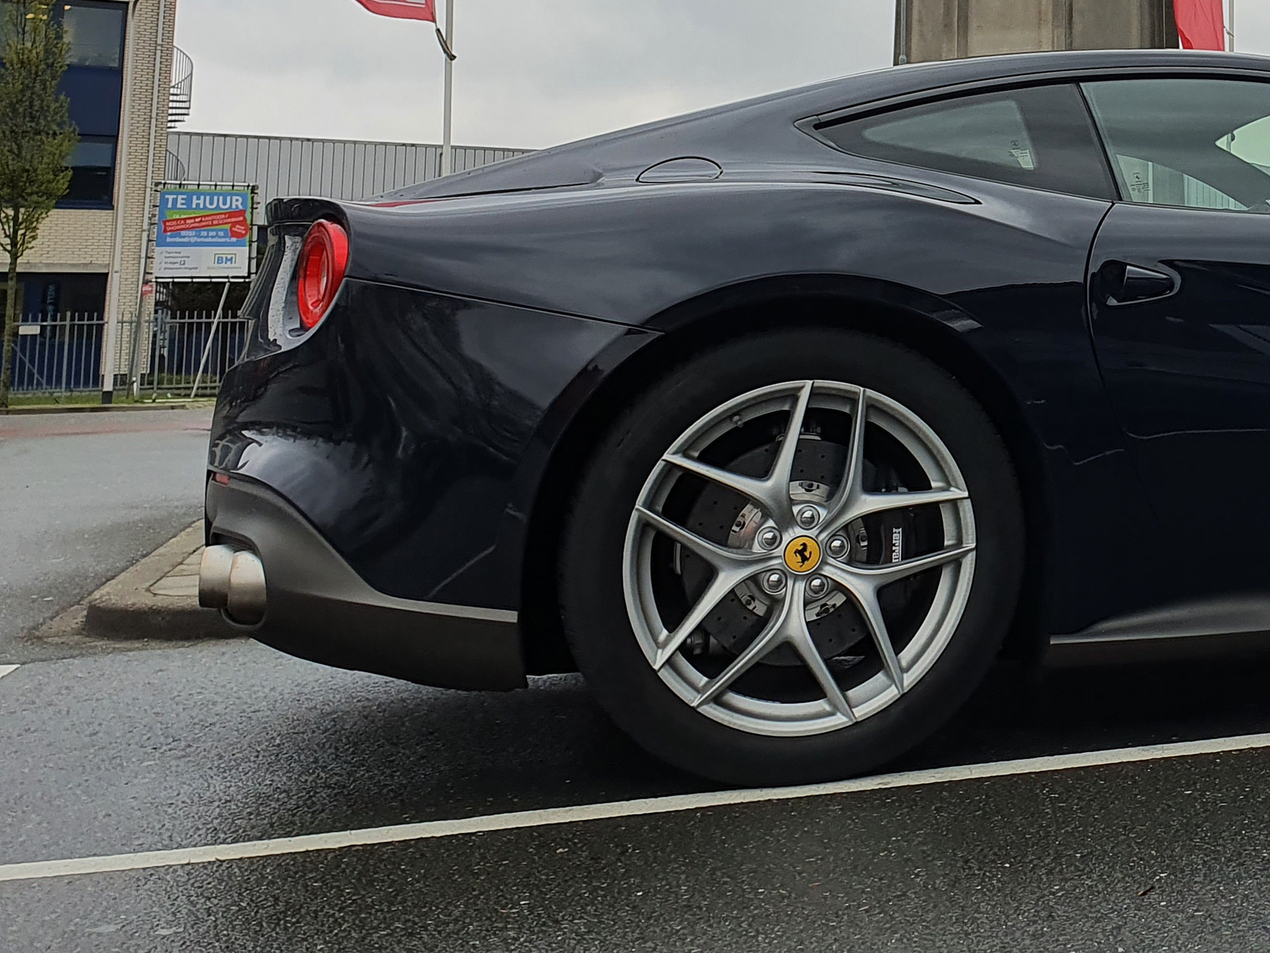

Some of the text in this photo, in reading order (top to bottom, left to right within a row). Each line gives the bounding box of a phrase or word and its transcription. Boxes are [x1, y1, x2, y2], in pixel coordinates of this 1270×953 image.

[165, 194, 243, 209] TE HUUR
[216, 256, 234, 264] BM
